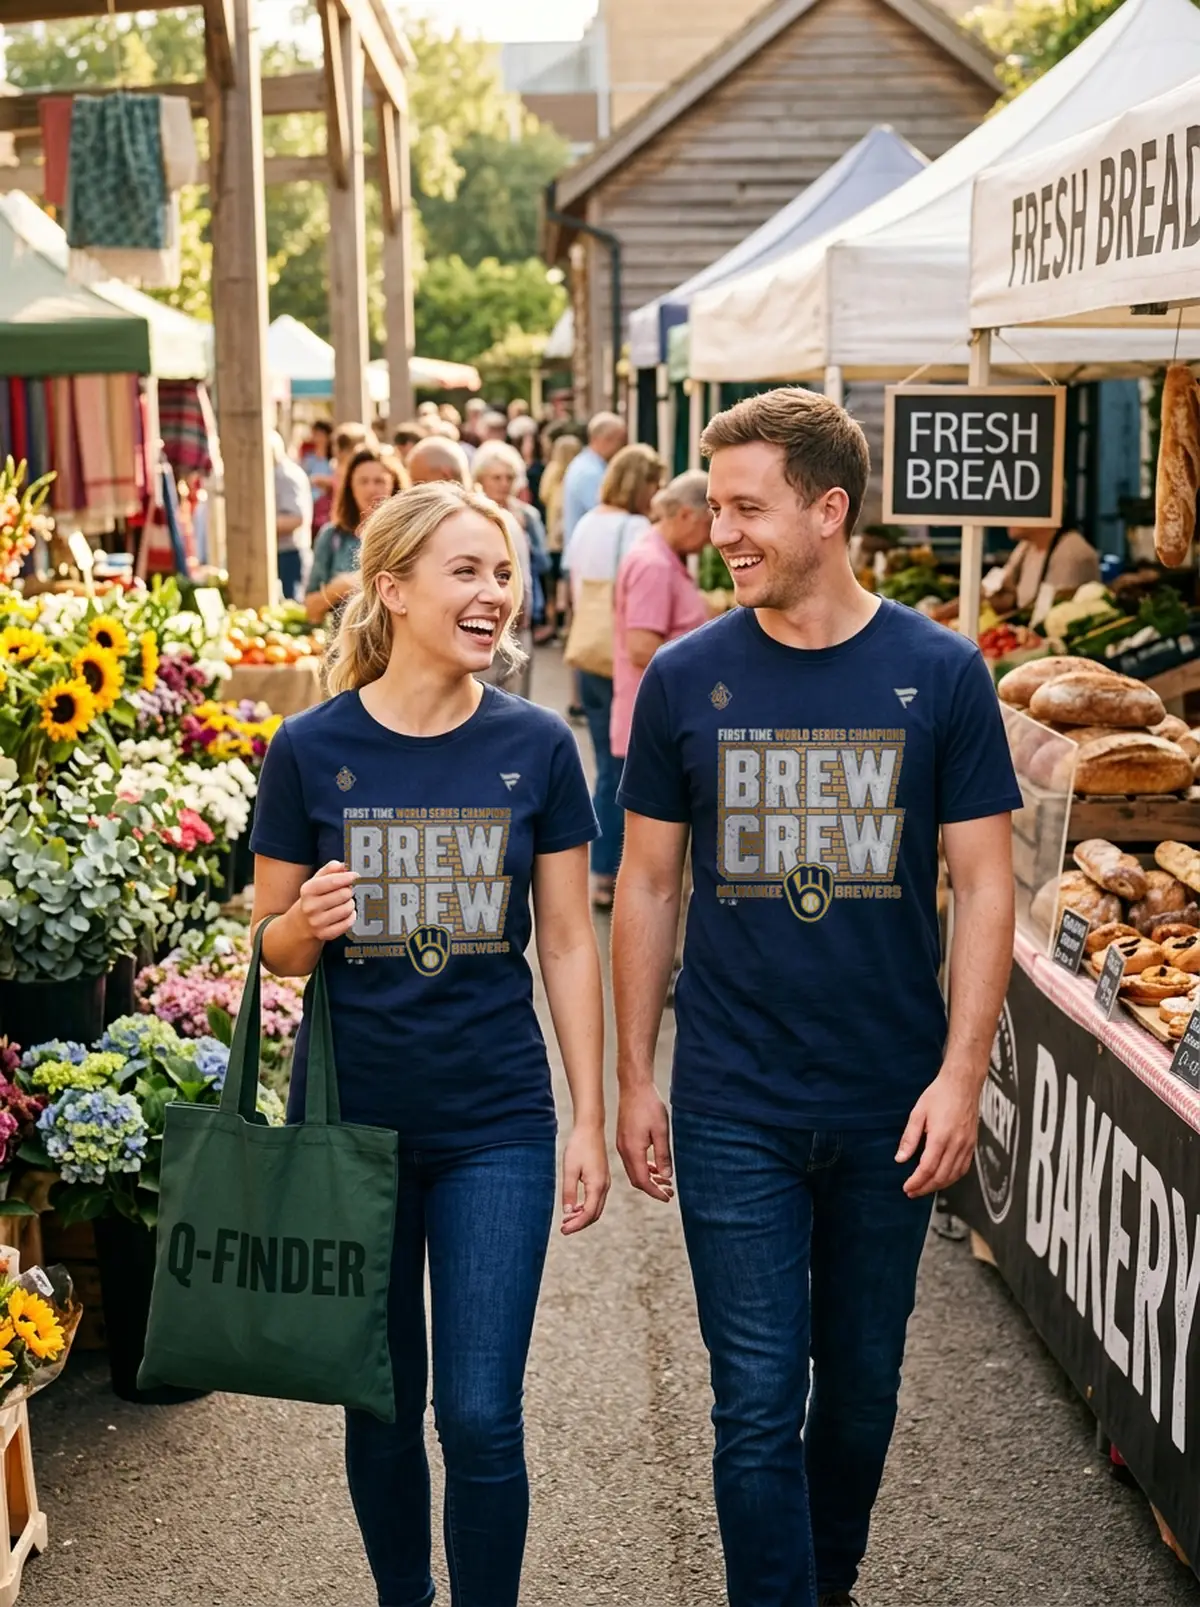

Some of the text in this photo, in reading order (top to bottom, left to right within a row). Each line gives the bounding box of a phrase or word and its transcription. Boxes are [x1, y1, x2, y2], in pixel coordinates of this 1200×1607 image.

[1008, 125, 1200, 287] FRESH BREAD
[910, 412, 1038, 454] FRESH
[907, 458, 1041, 501] BREAD
[718, 728, 746, 741] FIRST
[749, 728, 773, 741] TIME
[775, 728, 810, 741] WORLD
[812, 728, 847, 741] SERIES
[725, 749, 897, 808] BREW
[343, 807, 369, 819] FIRST
[372, 807, 394, 819] TIME
[395, 807, 427, 819] WORLD
[429, 807, 459, 819] SERIES
[351, 825, 504, 878] BREW
[724, 814, 898, 874] CREW
[351, 881, 505, 936] CREW
[834, 885, 902, 899] BREWERS
[451, 941, 510, 955] BREWERS
[168, 1222, 366, 1297] Q-FINDER
[1026, 1043, 1200, 1454] BAKERY
